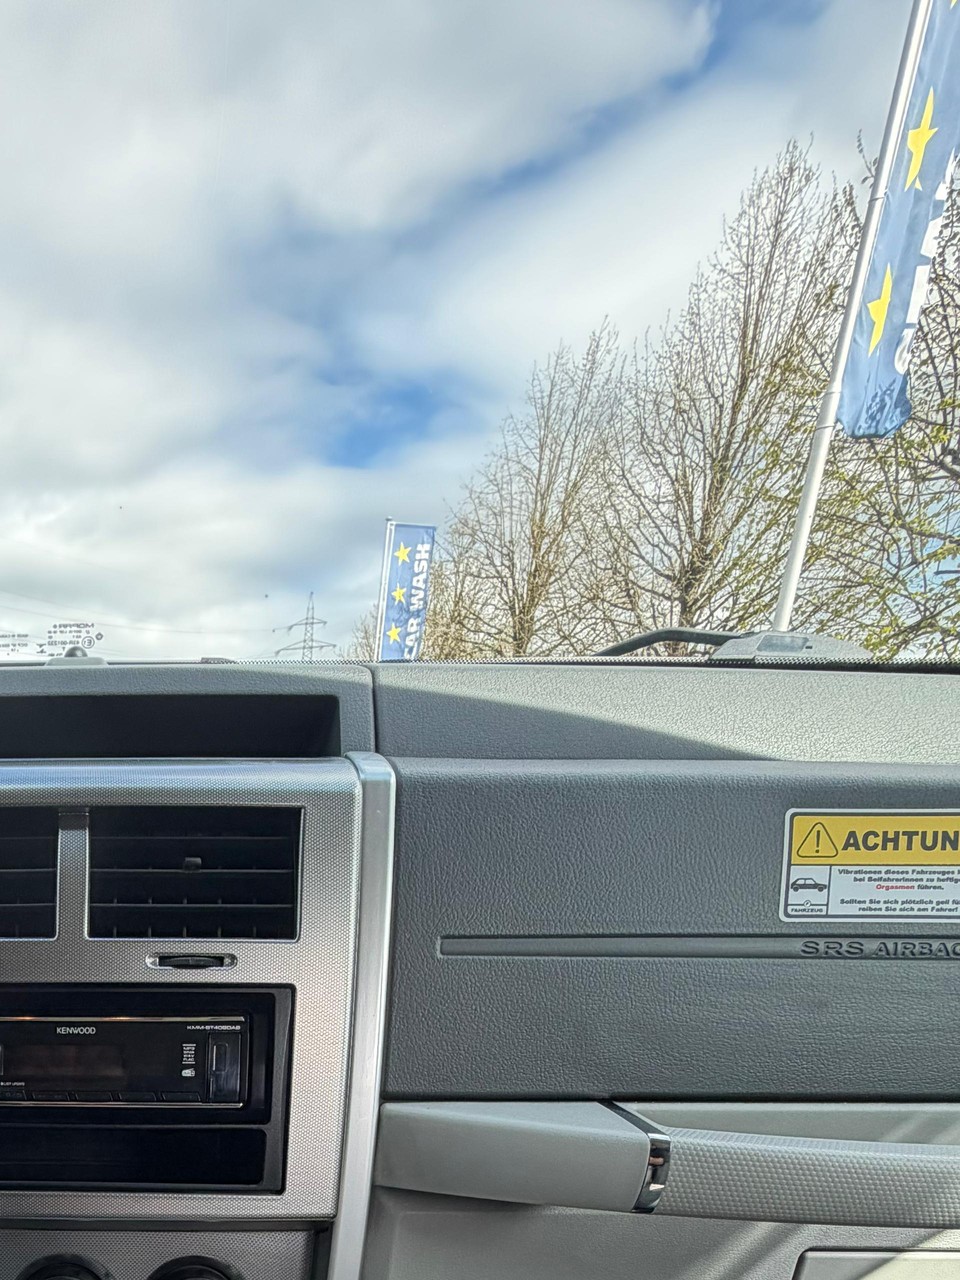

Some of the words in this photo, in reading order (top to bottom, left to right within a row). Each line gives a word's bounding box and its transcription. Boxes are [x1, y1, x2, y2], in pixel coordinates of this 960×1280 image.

[410, 543, 431, 611] WASH
[841, 830, 959, 851] ACHTUN
[801, 940, 865, 957] SRS
[56, 1026, 97, 1035] KENWOOD
